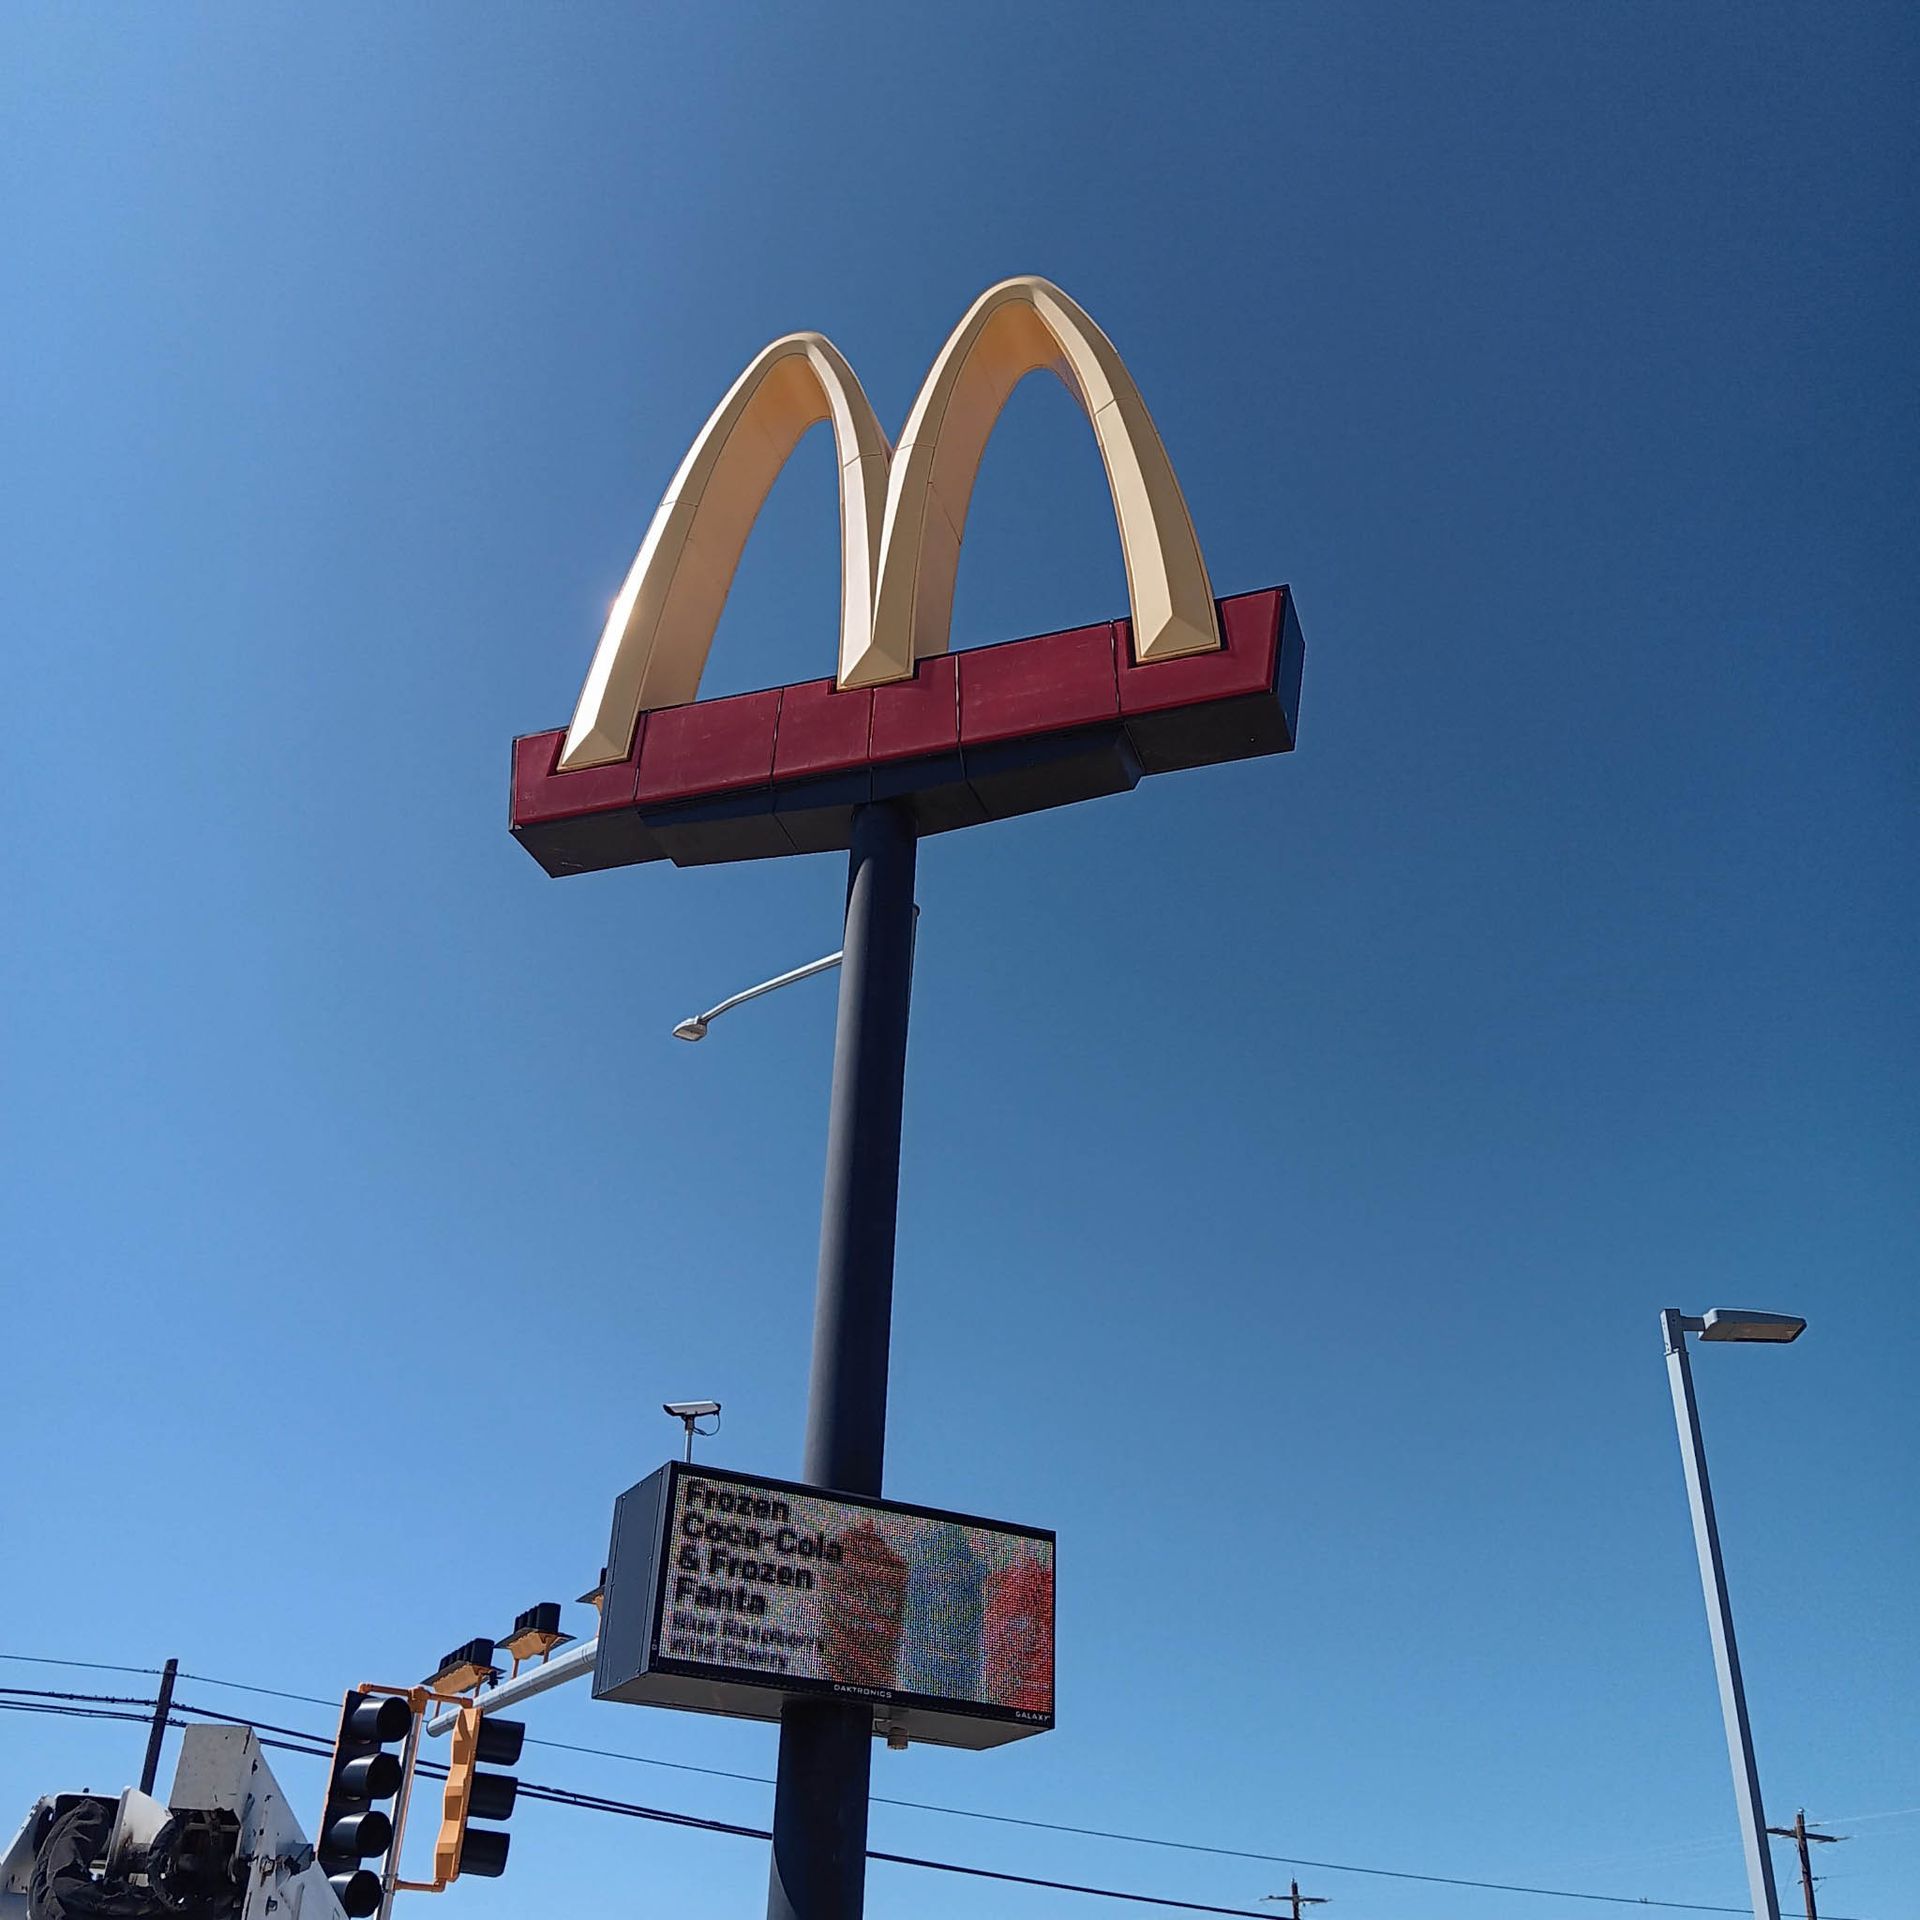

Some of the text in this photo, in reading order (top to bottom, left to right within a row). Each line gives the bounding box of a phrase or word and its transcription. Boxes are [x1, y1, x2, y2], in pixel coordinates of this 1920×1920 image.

[687, 1480, 790, 1521] Frozen
[683, 1510, 842, 1561] Coca-Cola
[679, 1544, 812, 1589] & Frozen
[676, 1576, 766, 1615] Fanta
[833, 1684, 893, 1699] DAKTRONICS
[1015, 1710, 1049, 1721] GALAXY
